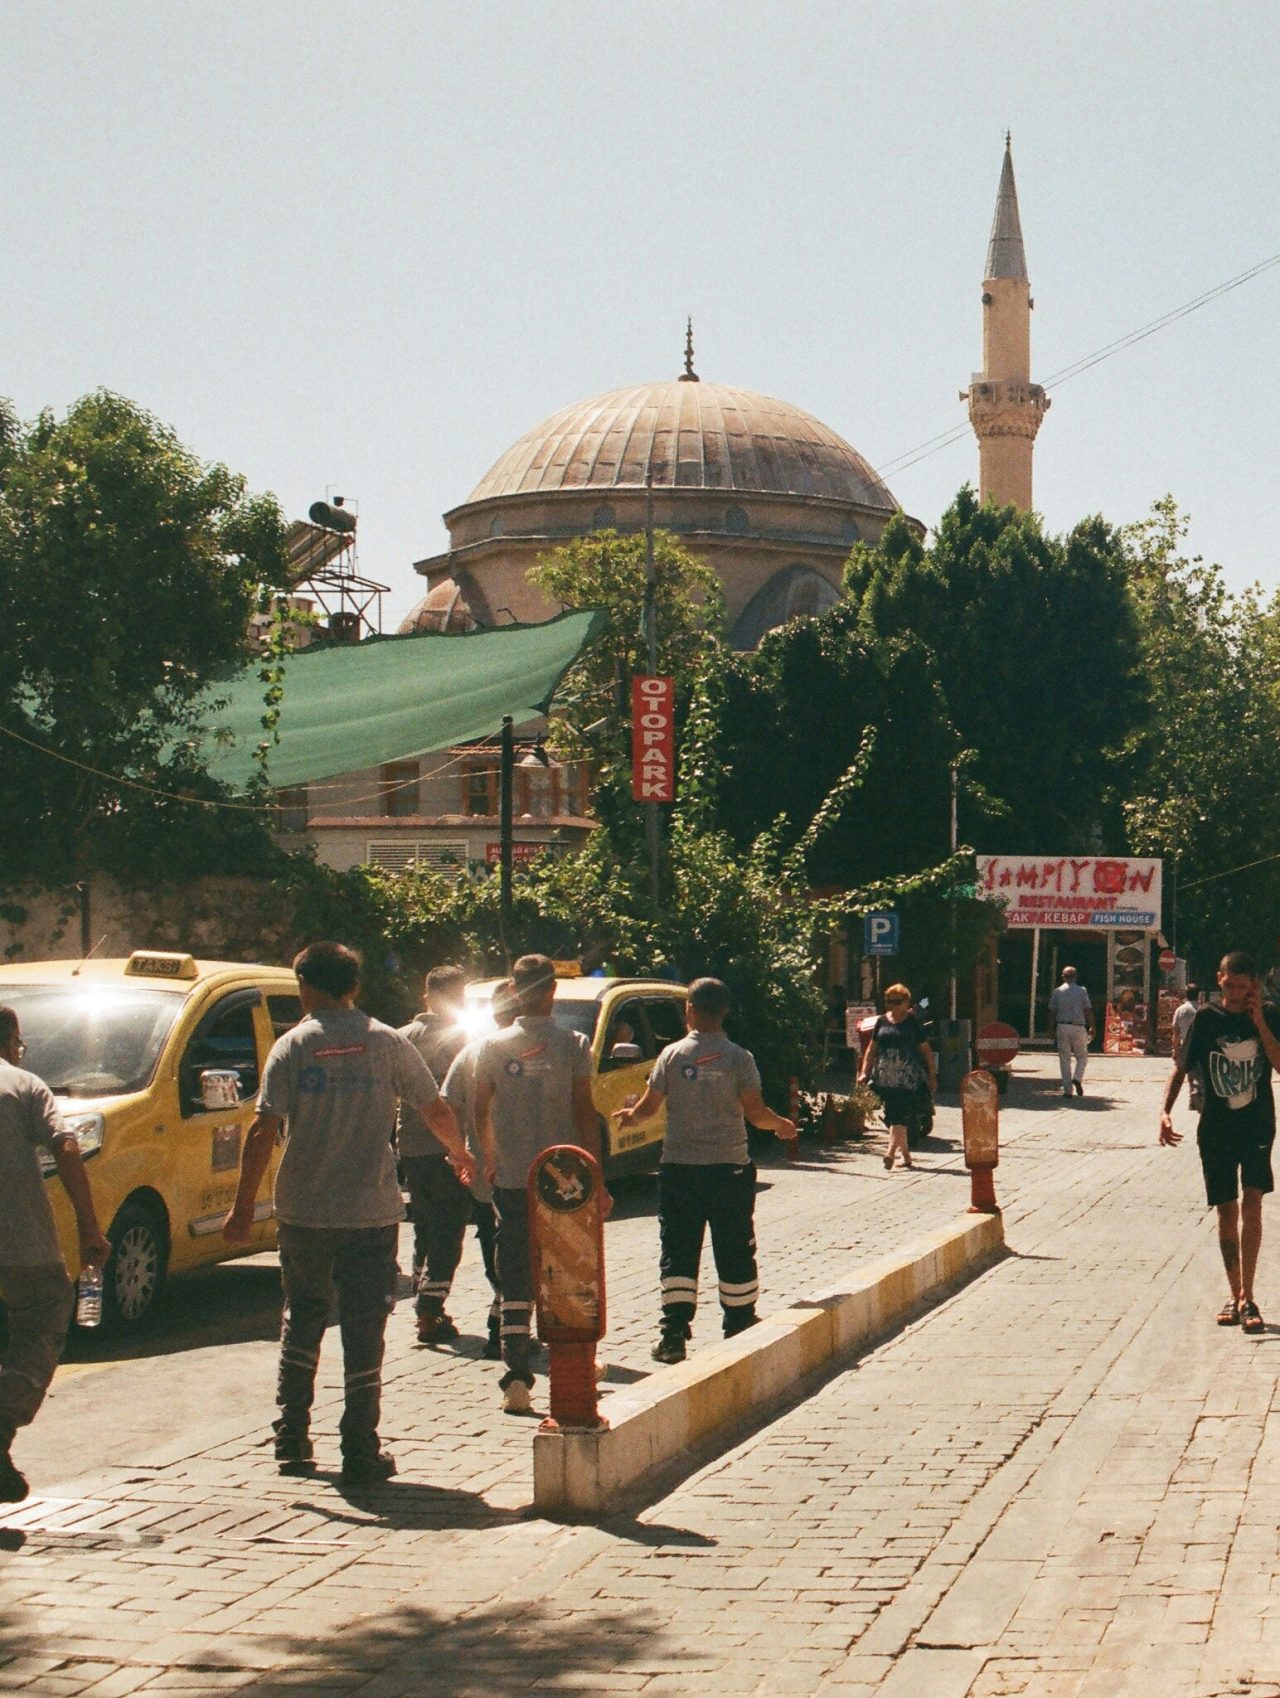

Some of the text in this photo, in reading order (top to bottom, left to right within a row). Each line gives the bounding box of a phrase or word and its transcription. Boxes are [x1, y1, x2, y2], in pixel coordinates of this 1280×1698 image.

[640, 679, 668, 797] OTOPARK
[1017, 894, 1118, 910] RESTAURANT
[1044, 911, 1085, 923] KEBAP
[1094, 914, 1151, 923] FISH HOUSE
[871, 917, 891, 943] P
